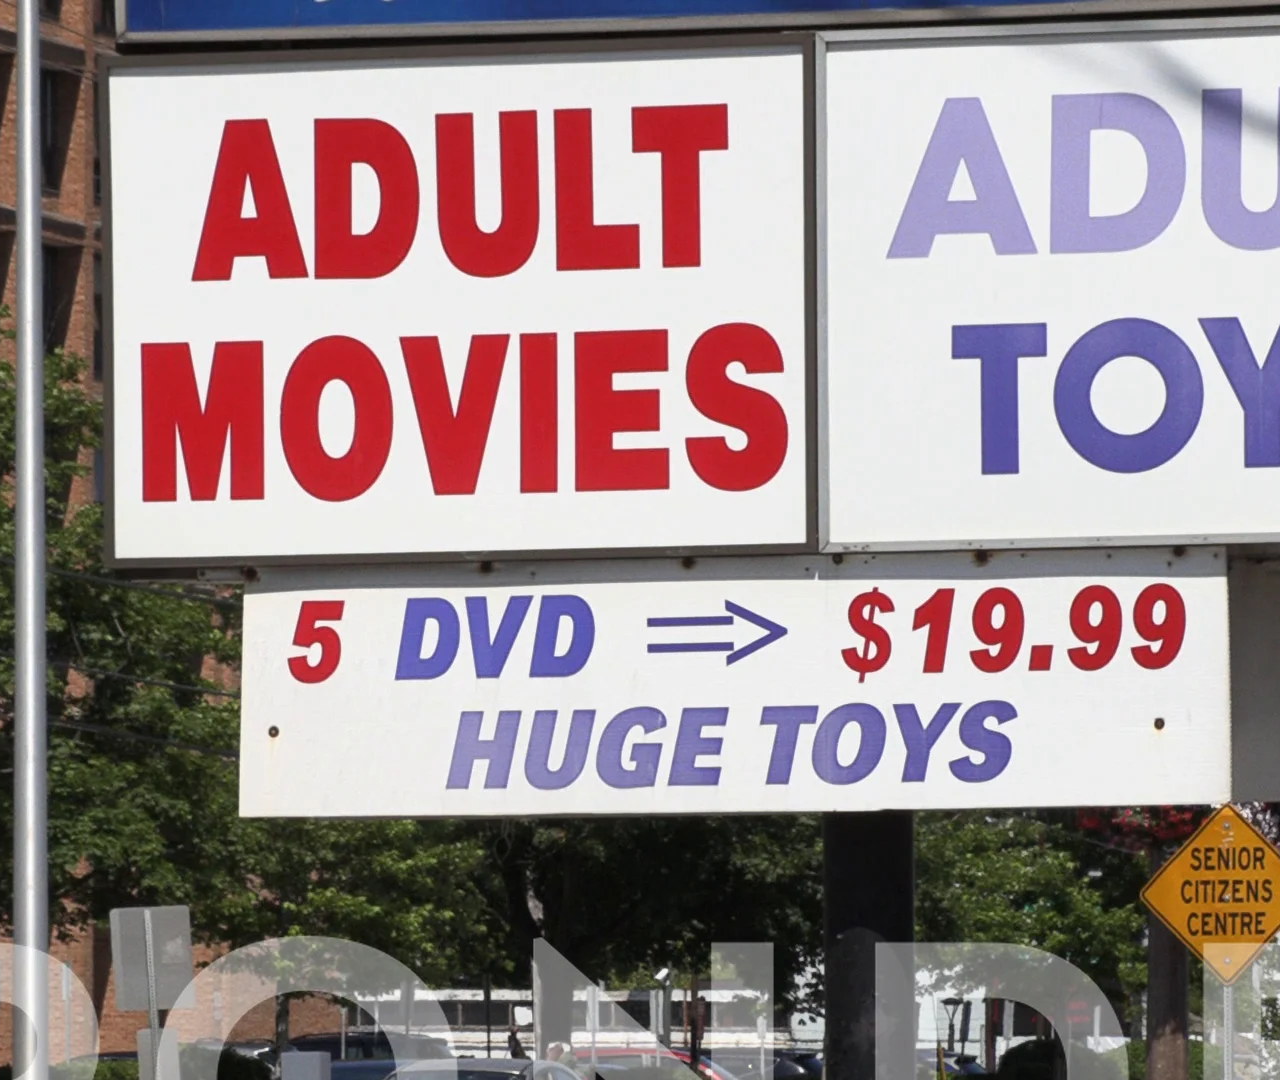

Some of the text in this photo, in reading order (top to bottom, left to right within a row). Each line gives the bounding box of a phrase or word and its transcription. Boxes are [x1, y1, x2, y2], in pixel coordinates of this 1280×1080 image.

[193, 104, 729, 281] ADULT
[142, 323, 789, 503] MOVIES
[288, 601, 345, 684] 5
[395, 595, 597, 681] DVD
[842, 583, 1186, 682] $19.99
[447, 700, 1019, 790] HUGE TOYS
[1180, 878, 1273, 904] CITIZENS
[1190, 847, 1266, 872] SENIOR
[1187, 912, 1267, 937] CENTRE
